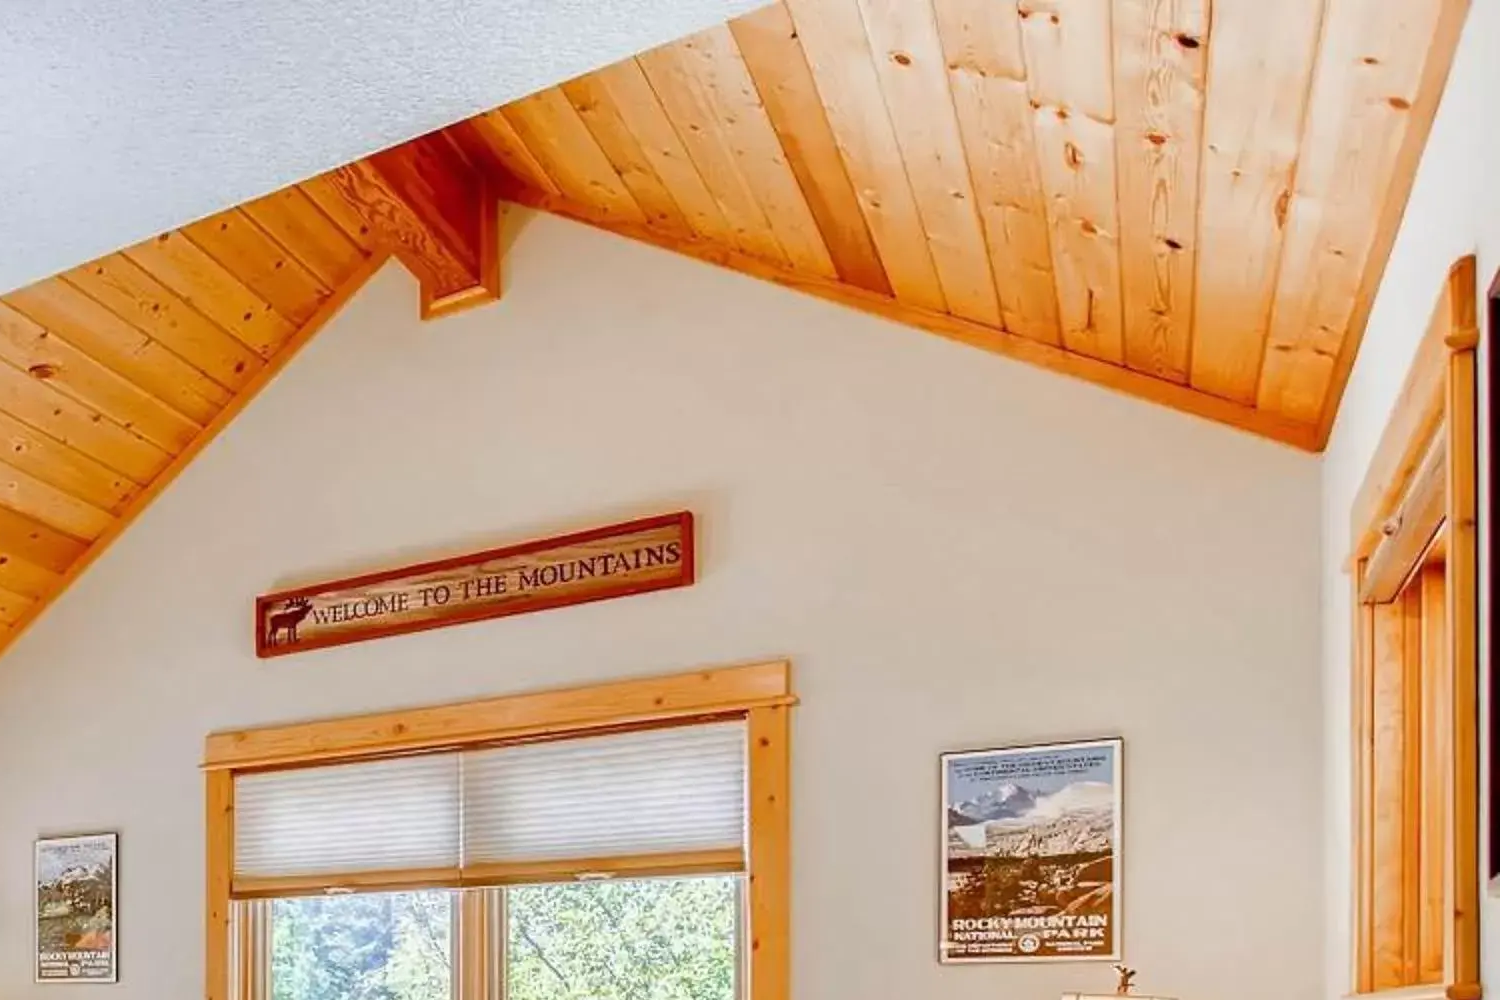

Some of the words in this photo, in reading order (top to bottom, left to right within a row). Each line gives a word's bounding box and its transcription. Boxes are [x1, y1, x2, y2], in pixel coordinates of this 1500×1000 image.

[314, 593, 409, 625] WELCOME
[420, 586, 450, 607] TO
[457, 575, 507, 600] THE
[518, 542, 681, 591] MOUNTAINS
[952, 917, 1013, 931] ROCKY
[1014, 914, 1108, 929] MOUNTAIN
[953, 930, 1013, 941] NATIONAL
[1043, 927, 1105, 939] PARK
